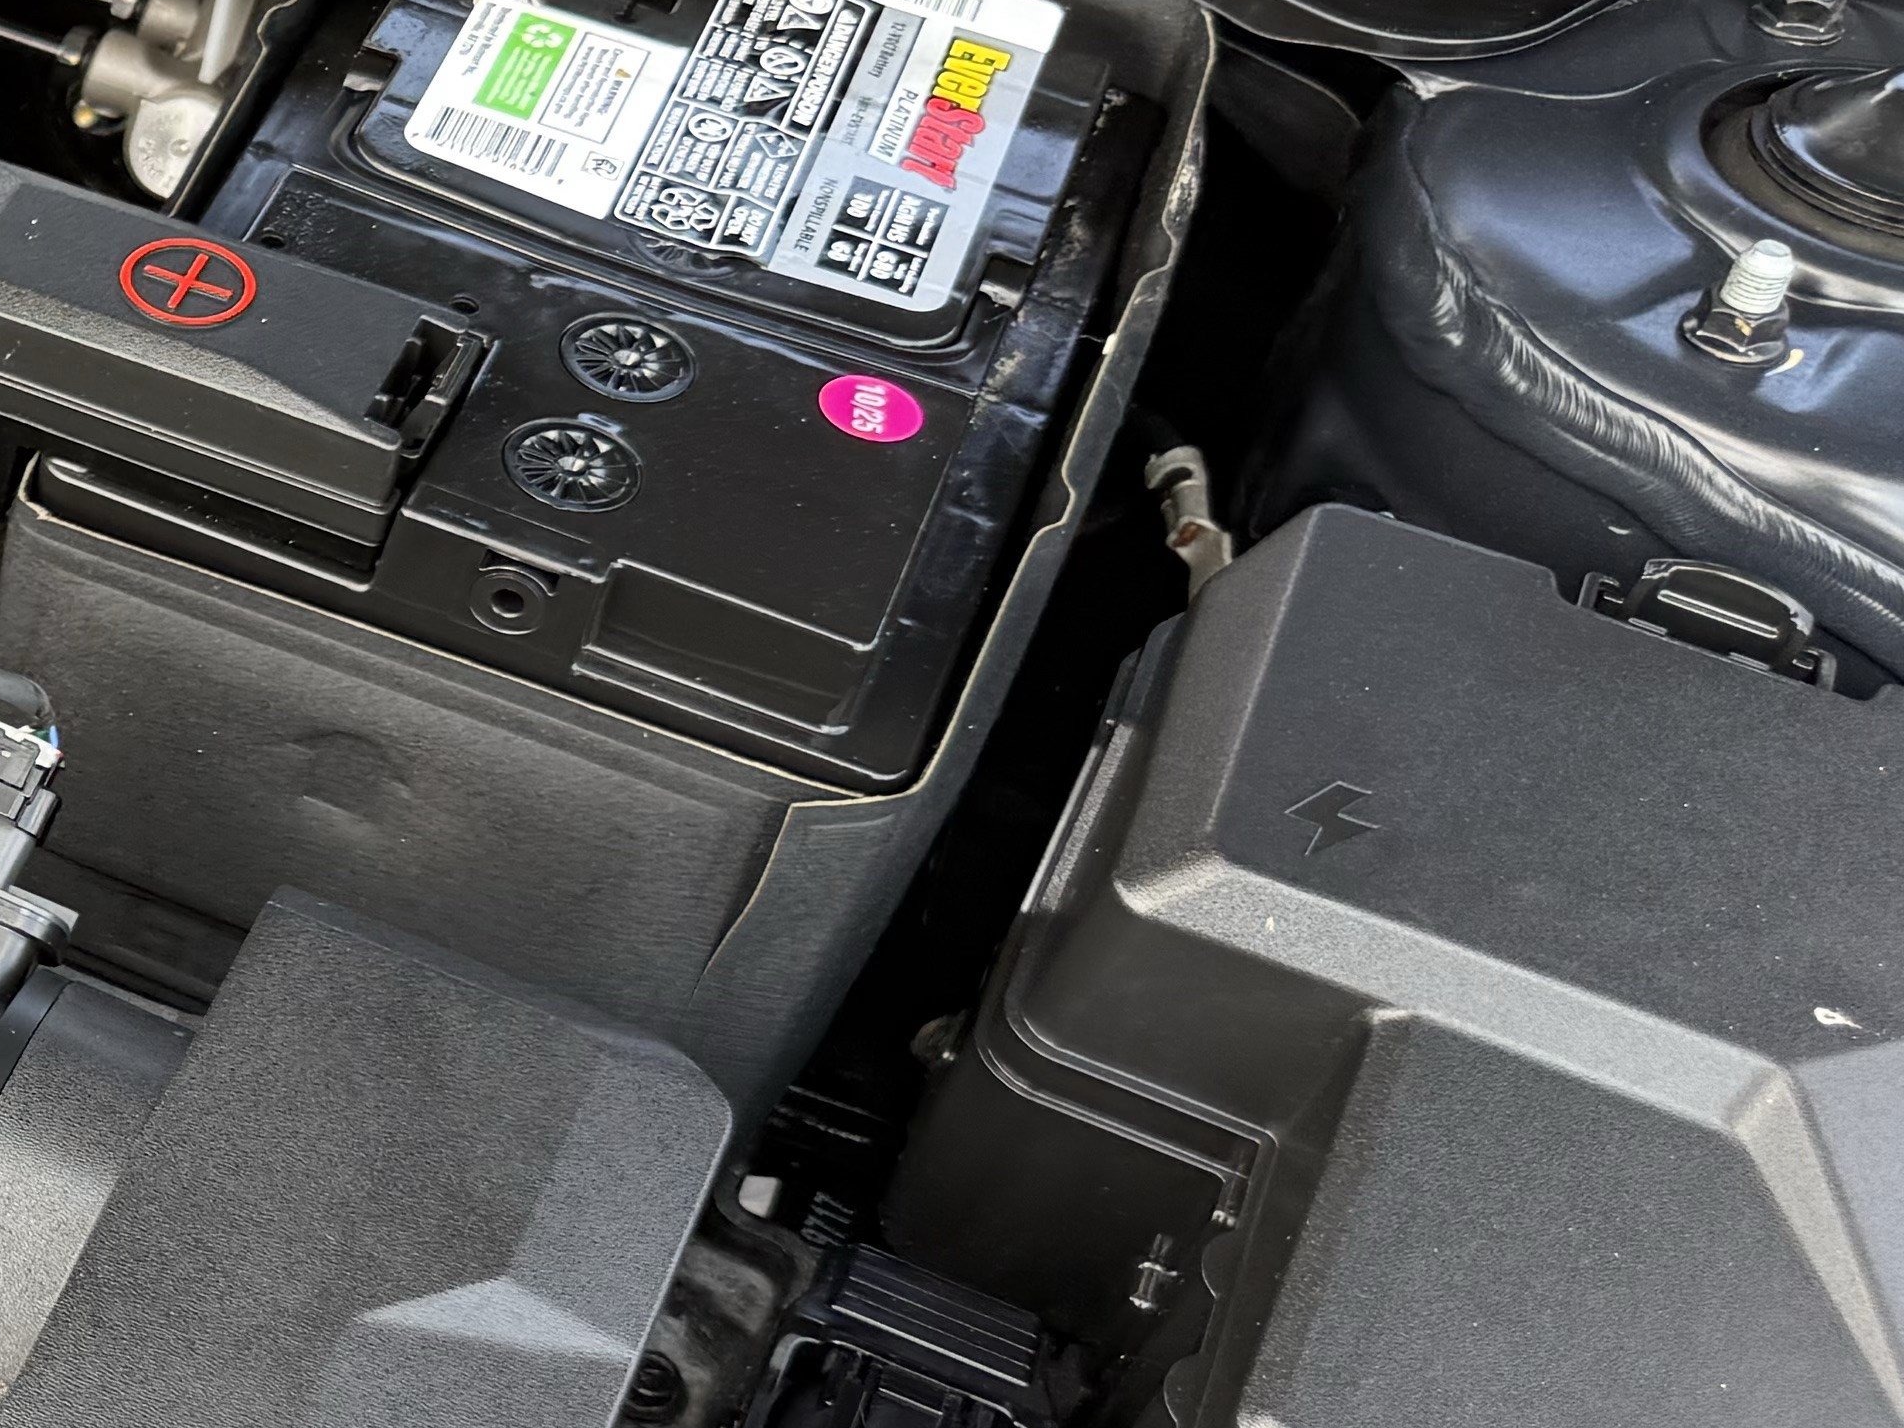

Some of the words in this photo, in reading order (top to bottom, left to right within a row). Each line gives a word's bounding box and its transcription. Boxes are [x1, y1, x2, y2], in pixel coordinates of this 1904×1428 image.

[874, 88, 920, 158] PLATINUM
[895, 36, 1014, 192] EverStart
[793, 177, 840, 252] NONSPILLABLE
[844, 191, 874, 219] 100
[892, 194, 922, 225] AGM
[825, 238, 855, 263] 60
[867, 249, 899, 281] 680
[849, 384, 887, 435] 10/25
